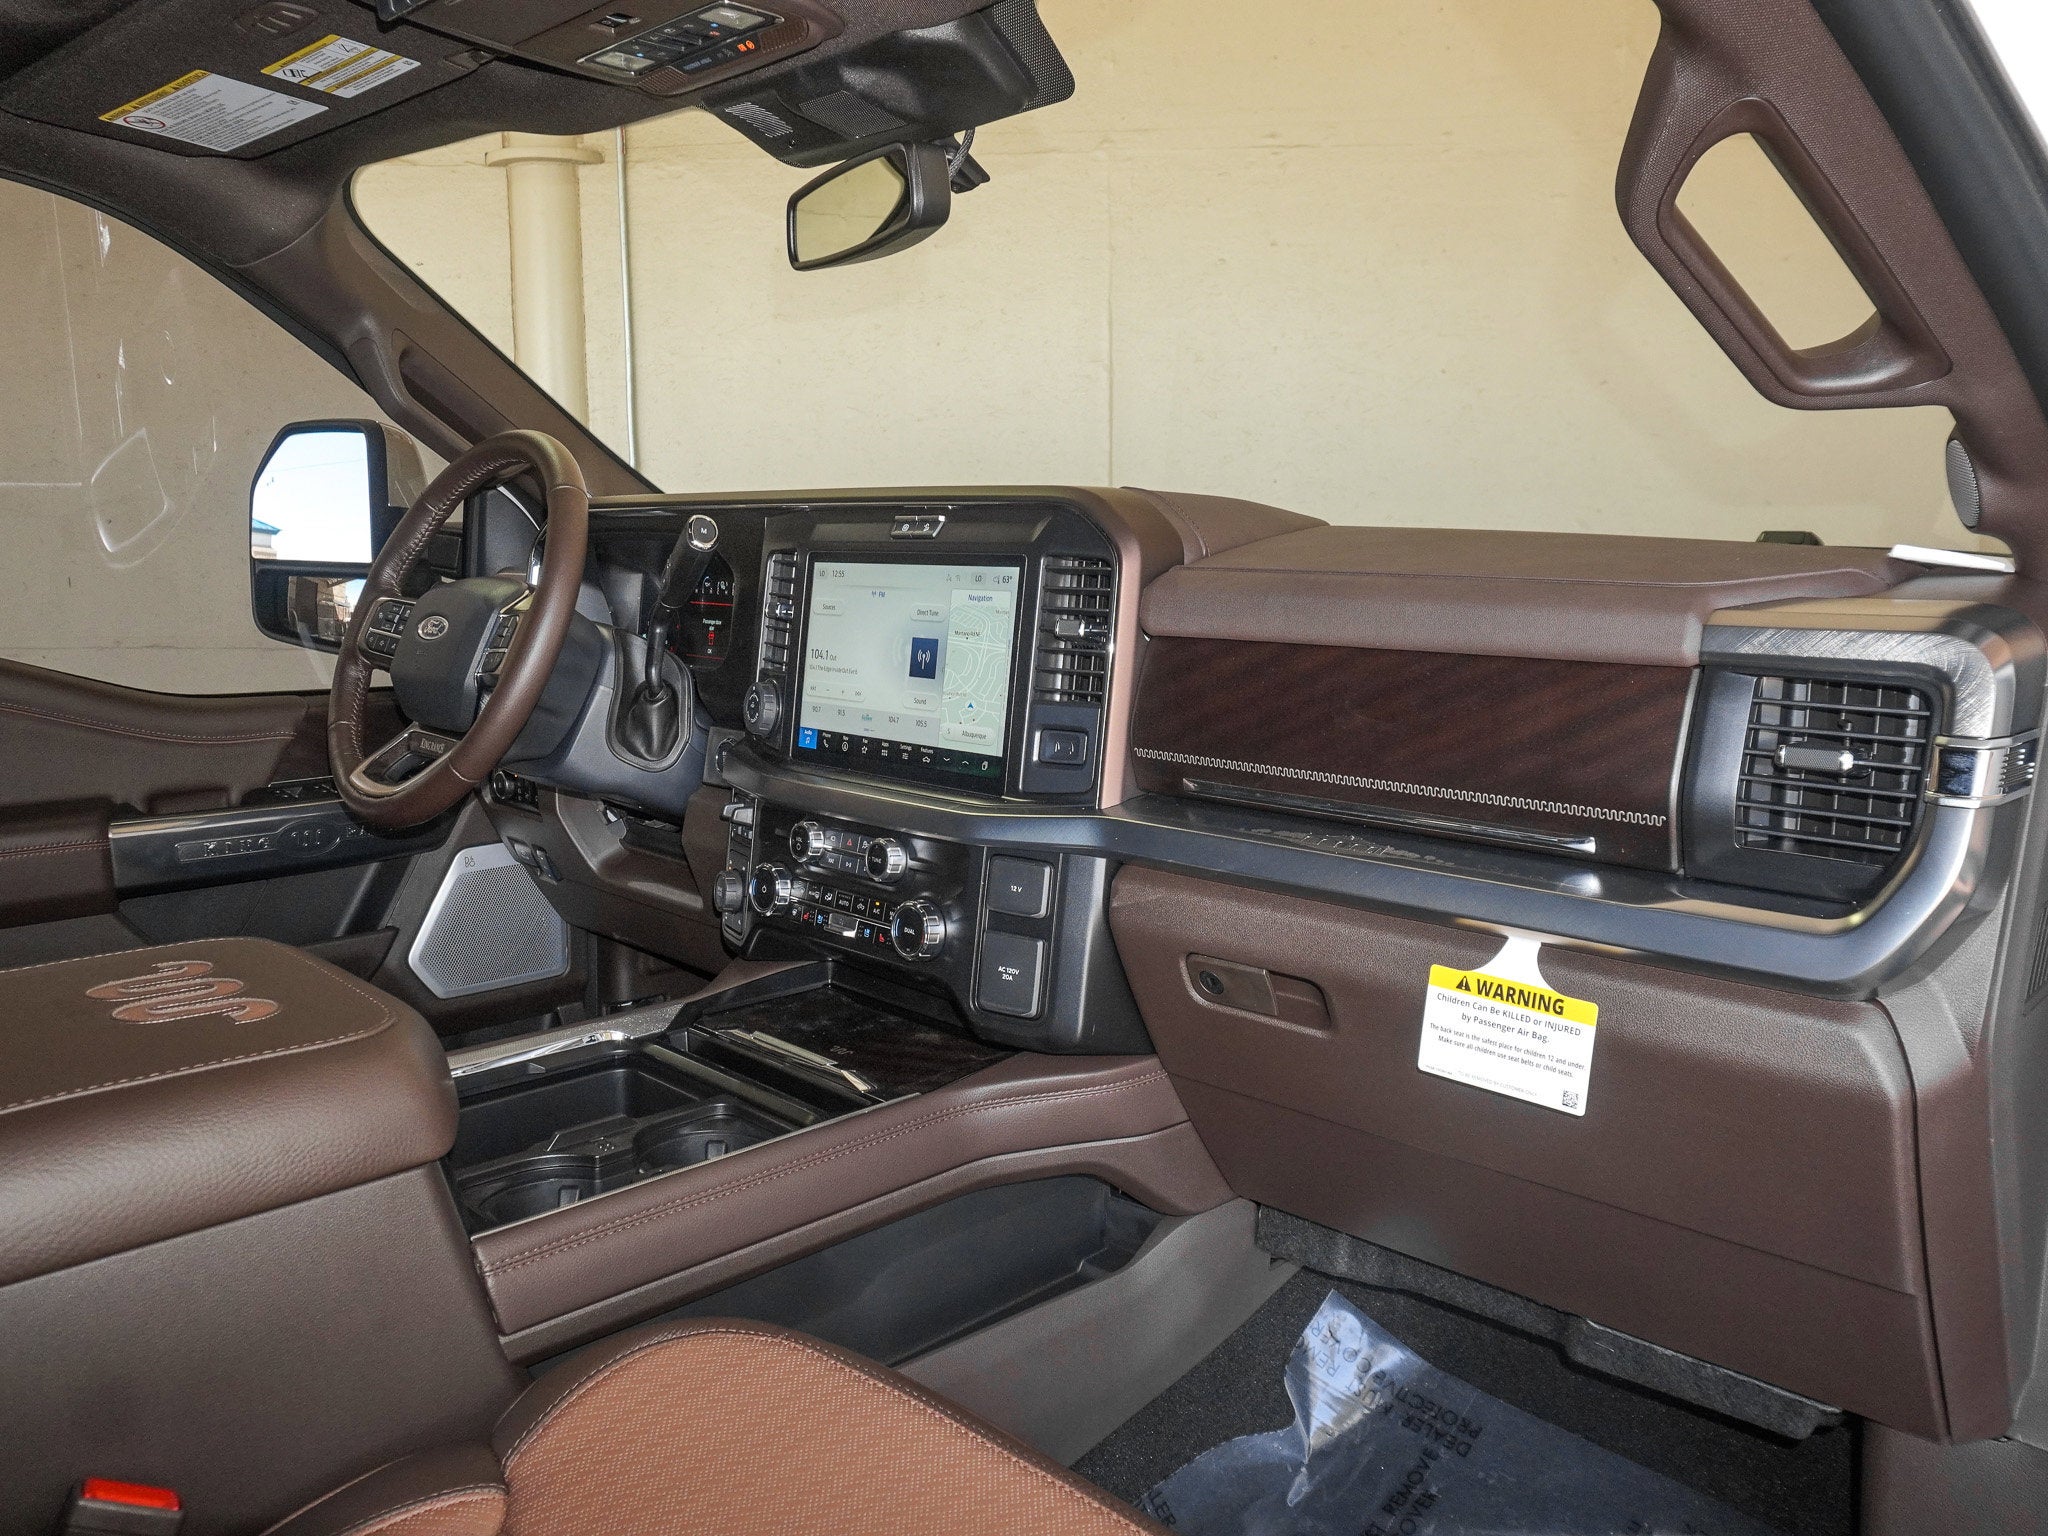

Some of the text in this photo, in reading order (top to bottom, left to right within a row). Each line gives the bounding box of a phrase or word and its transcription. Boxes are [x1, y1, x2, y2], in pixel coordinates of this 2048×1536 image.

[832, 570, 845, 578] 12:55
[1002, 575, 1012, 584] 63°
[968, 594, 993, 603] Navigation
[811, 648, 828, 660] 104.1
[913, 697, 926, 705] Sound
[915, 719, 928, 728] 105.5
[904, 926, 916, 936] DUAL
[1002, 973, 1013, 981] 20A
[1006, 967, 1020, 975] 120V
[1476, 978, 1565, 1016] WARNING
[1437, 992, 1470, 1008] Children
[1472, 1002, 1488, 1012] Can
[1490, 1006, 1501, 1016] Be
[1502, 1010, 1531, 1024] KILLED
[1544, 1020, 1581, 1036] INJURED
[1462, 1012, 1550, 1044] by Passenger Air Bag.
[1430, 1022, 1439, 1030] The
[1440, 1026, 1452, 1034] back
[1481, 1038, 1497, 1046] safest
[1498, 1041, 1513, 1051] place
[1514, 1045, 1522, 1053] for
[1524, 1049, 1546, 1060] children
[1438, 1035, 1453, 1045] Make
[1454, 1040, 1465, 1048] sure
[1474, 1046, 1496, 1056] children
[1497, 1052, 1506, 1060] use
[1508, 1055, 1520, 1063] seat
[1520, 1058, 1534, 1068] belts
[1543, 1064, 1557, 1073] child
[1310, 1321, 1484, 1439] PROTECTIVE COVER
[1401, 1414, 1472, 1458] DEALER
[1381, 1448, 1440, 1517] REMOVE
